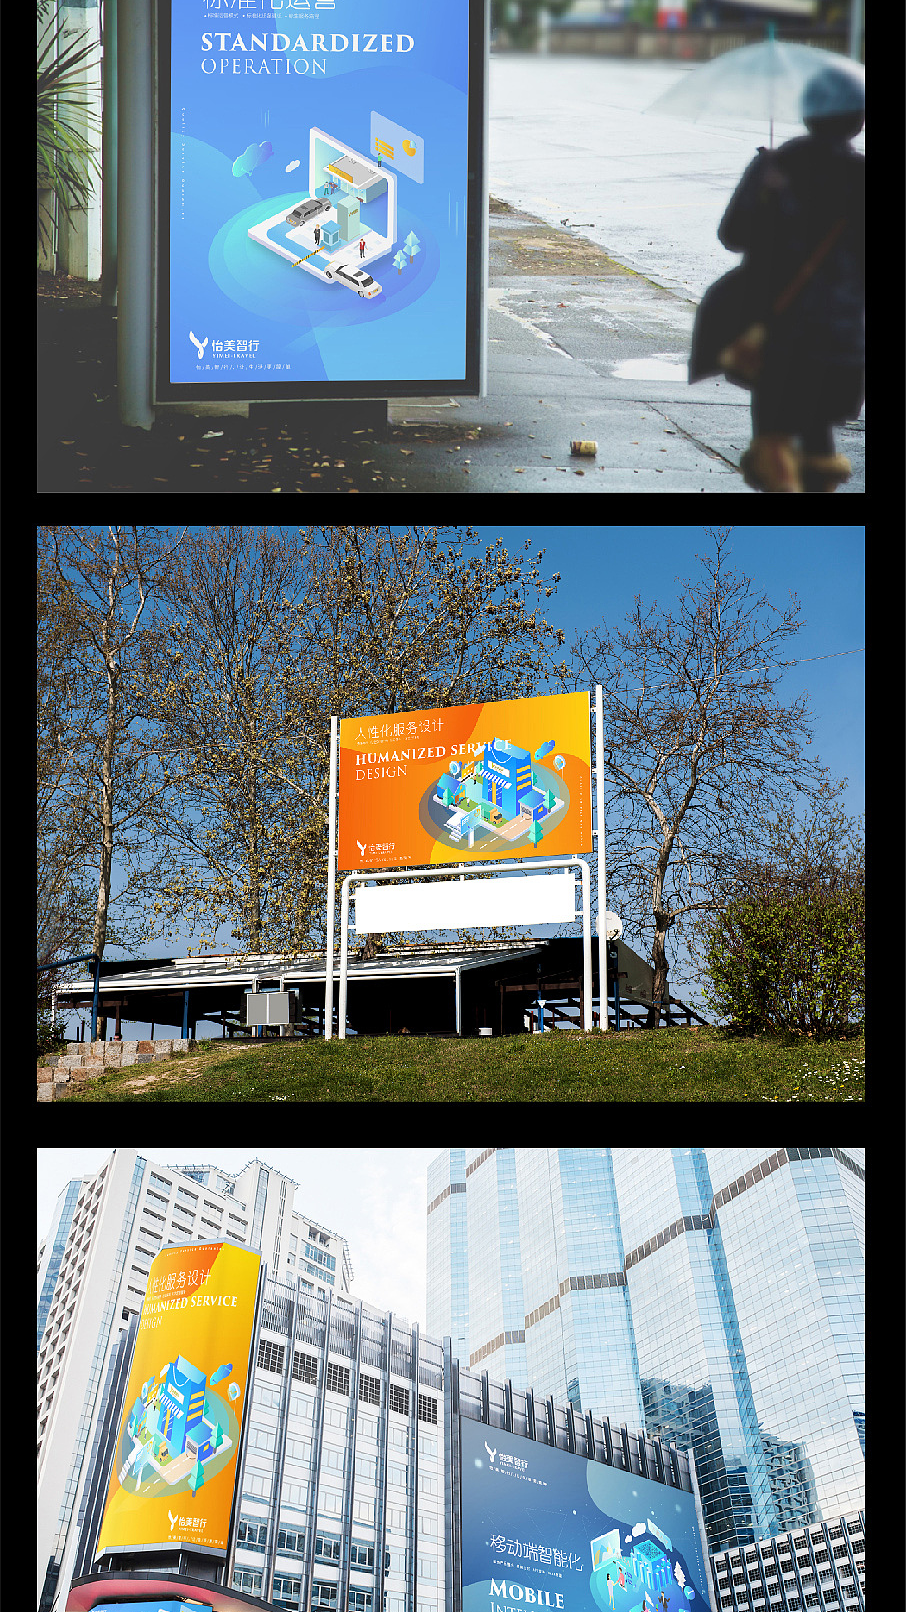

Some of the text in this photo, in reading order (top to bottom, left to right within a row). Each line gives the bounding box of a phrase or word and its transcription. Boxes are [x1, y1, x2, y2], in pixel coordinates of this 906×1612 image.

[201, 32, 415, 53] STANDARDIZED
[201, 58, 327, 75] OPERATION
[212, 339, 260, 352] 怡美智行
[355, 718, 444, 740] 人性化服务设计
[355, 739, 512, 766] HUMANIZED SERVICE
[355, 765, 408, 781] DESIGN
[191, 1296, 237, 1308] SERVICE
